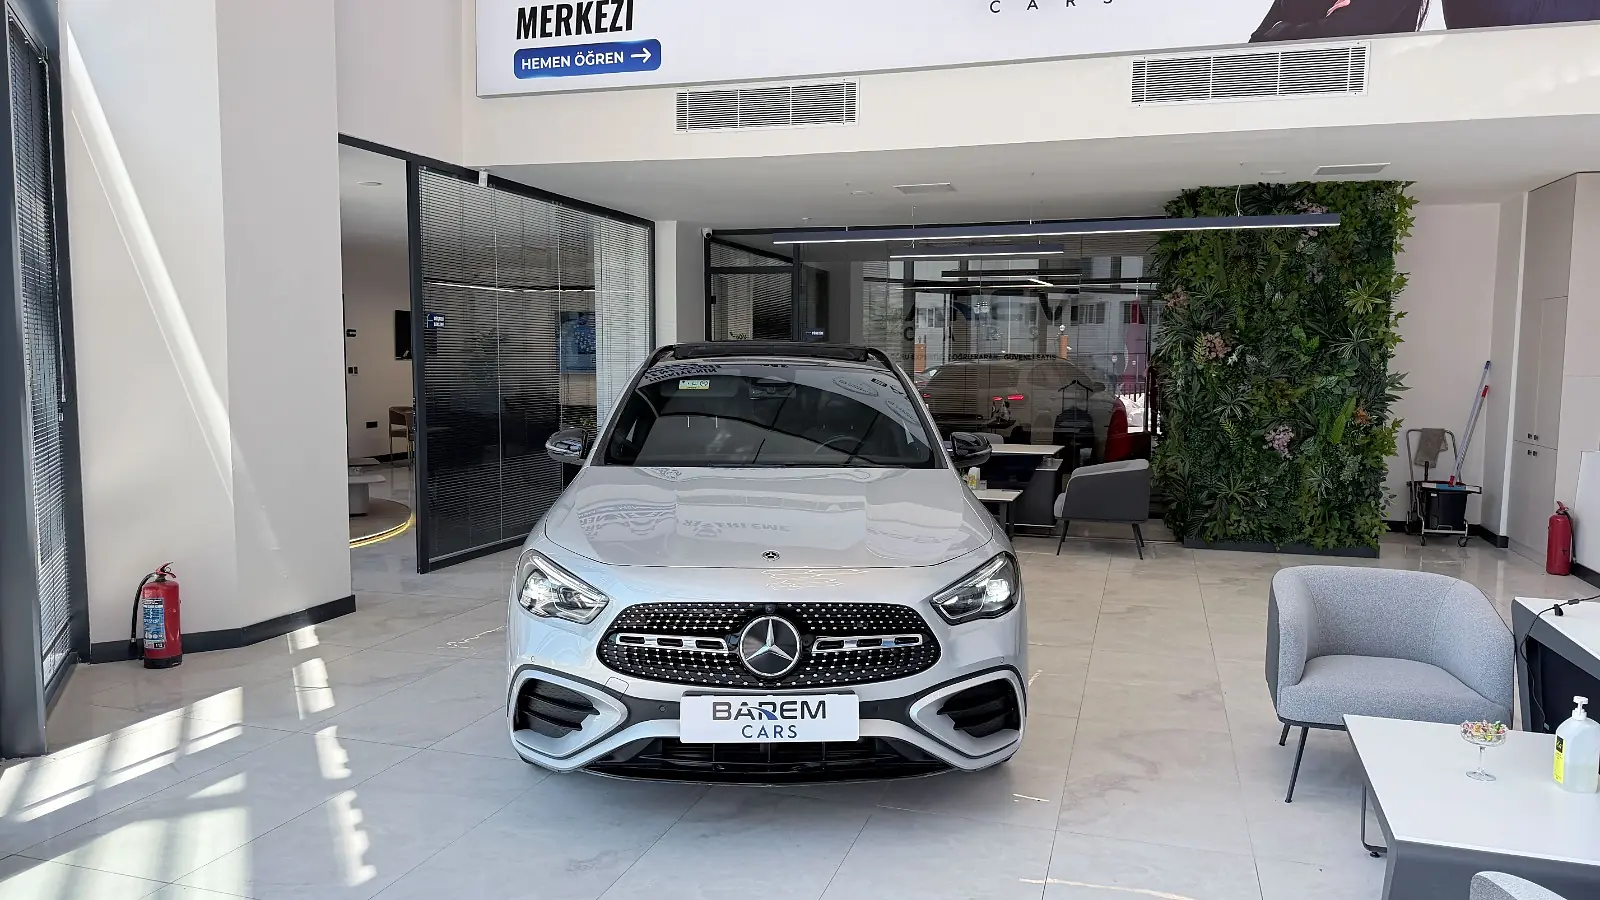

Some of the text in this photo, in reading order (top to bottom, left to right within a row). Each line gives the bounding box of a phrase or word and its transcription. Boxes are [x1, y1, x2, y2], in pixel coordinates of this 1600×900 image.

[989, 0, 1113, 13] CAR
[521, 50, 624, 70] HEMEN ÖĞREN
[712, 700, 827, 721] BAREM
[741, 724, 798, 739] CARS
